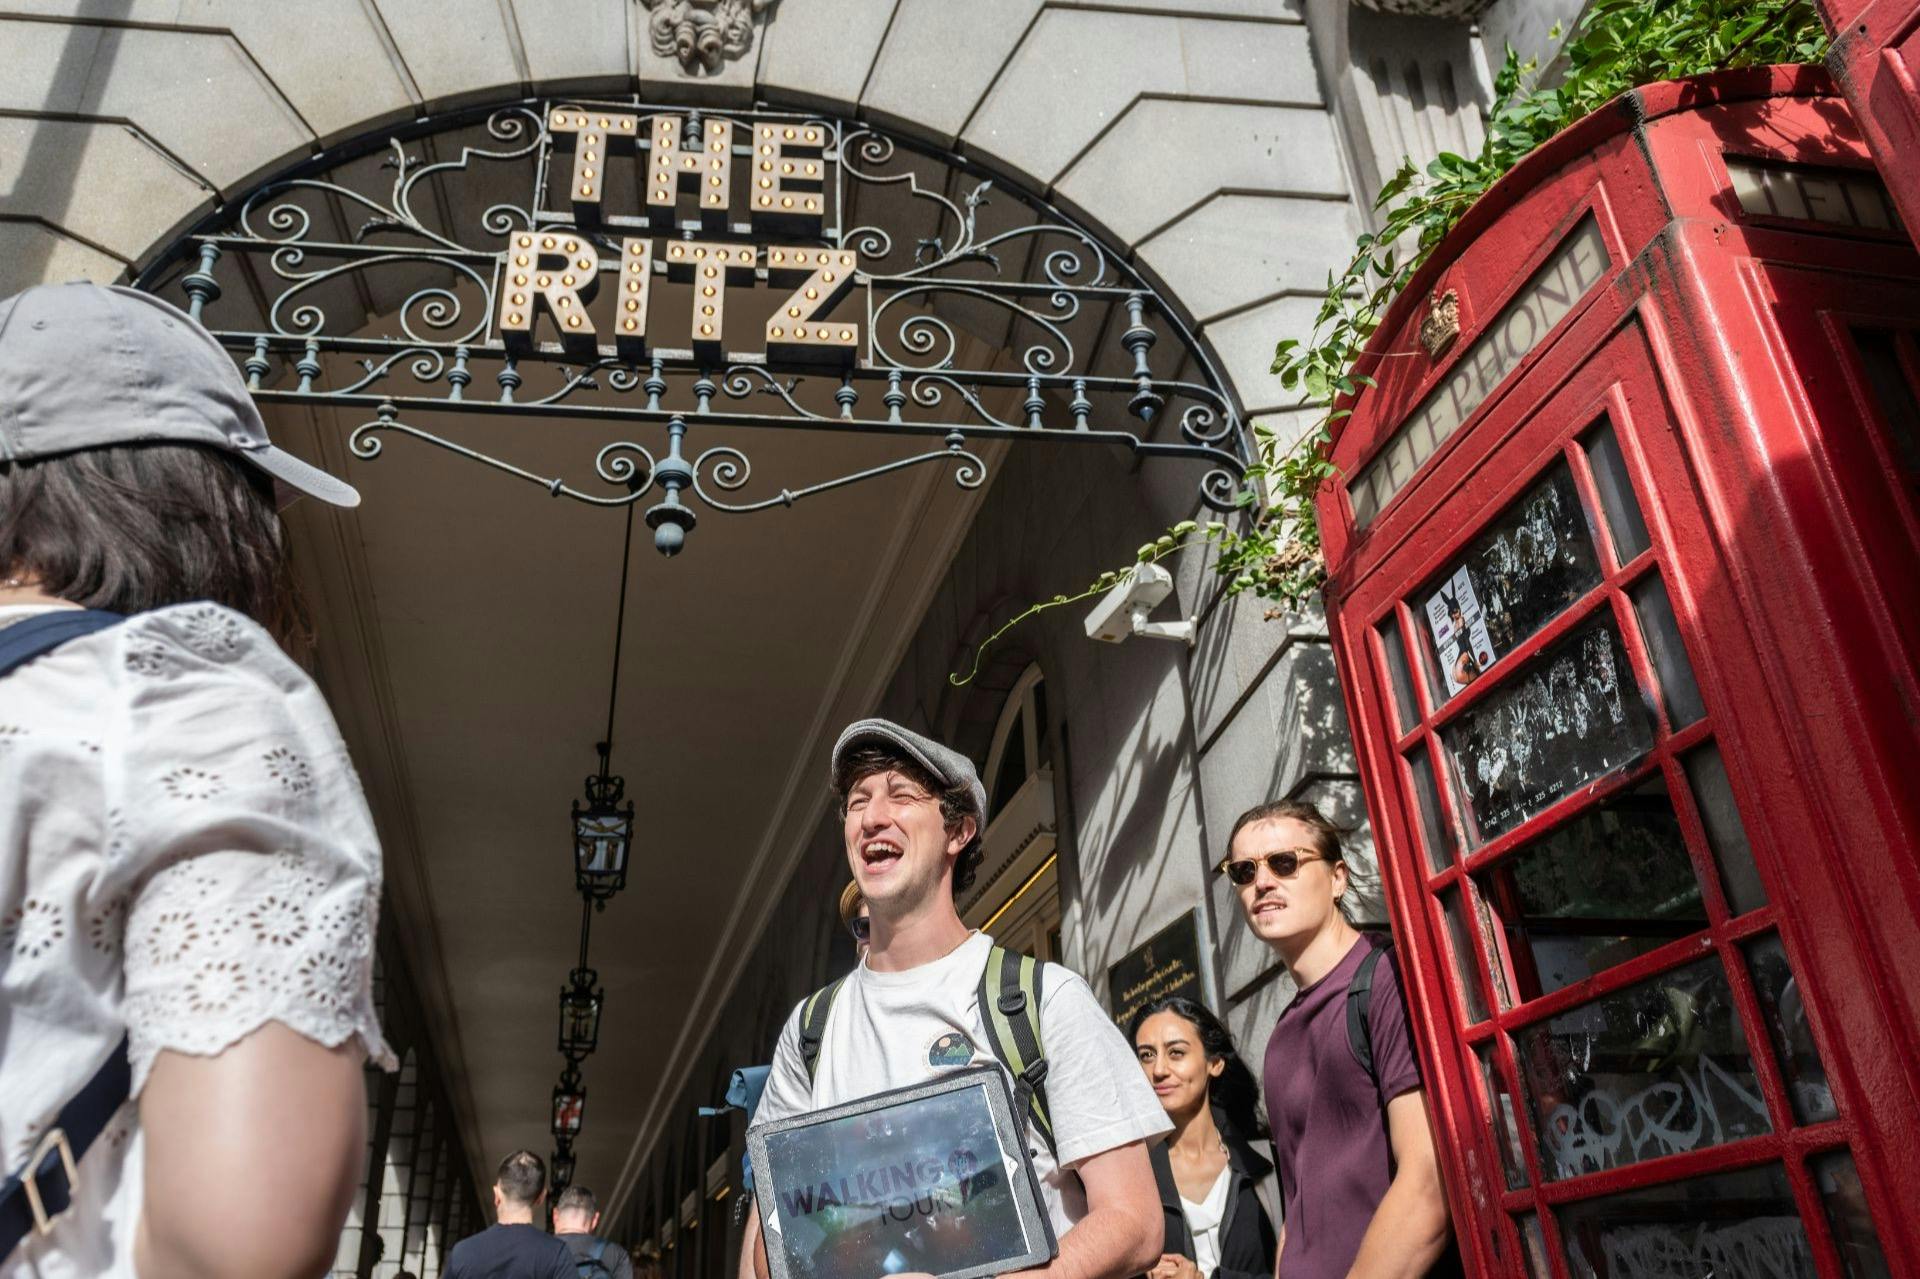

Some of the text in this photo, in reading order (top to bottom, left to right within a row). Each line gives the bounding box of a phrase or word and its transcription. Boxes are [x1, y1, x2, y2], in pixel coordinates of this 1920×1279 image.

[548, 109, 825, 214] THE
[500, 230, 859, 347] RITZ
[1364, 236, 1599, 511] TELEPHONE
[781, 1156, 944, 1219] WALKING
